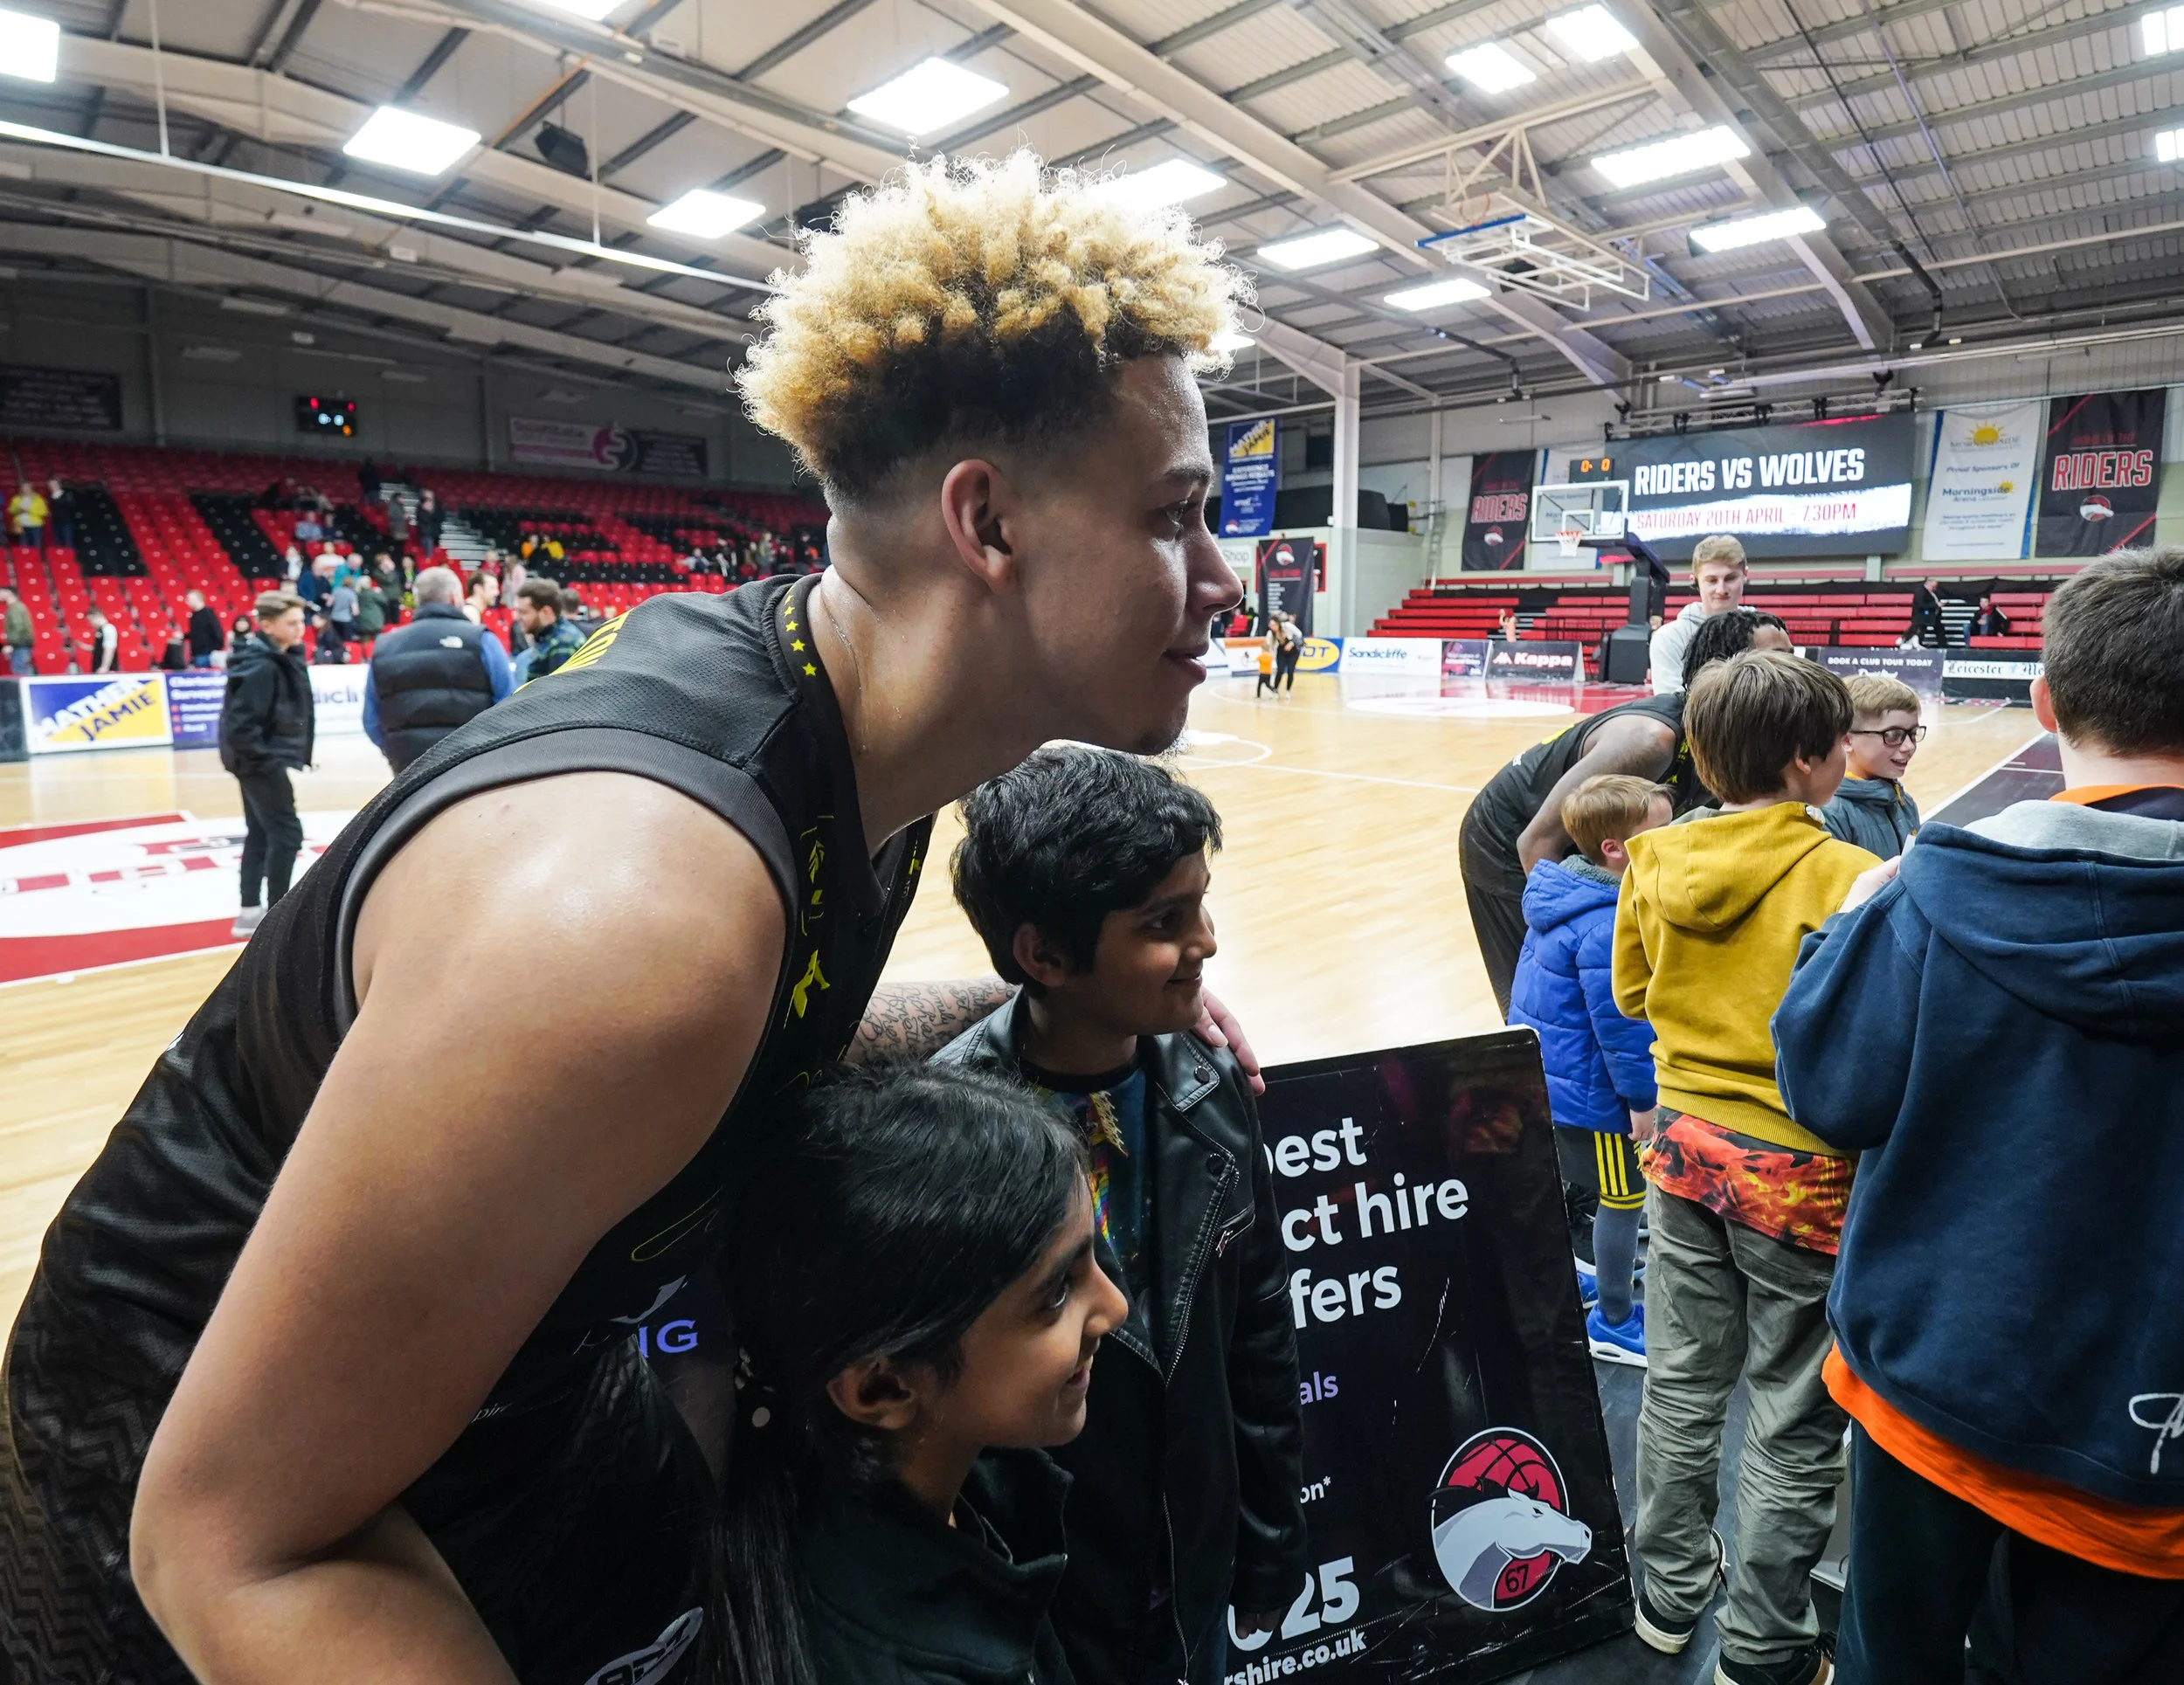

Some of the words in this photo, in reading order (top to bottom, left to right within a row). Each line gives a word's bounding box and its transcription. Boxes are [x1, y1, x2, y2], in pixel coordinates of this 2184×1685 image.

[1634, 459, 1716, 495] RIDERS
[1721, 457, 1752, 490] VS
[1759, 447, 1865, 487] WOLVES
[2052, 449, 2153, 492] RIDERS
[1942, 486, 2010, 497] Morningside
[1471, 493, 1528, 524] RIDERS
[1636, 510, 1701, 530] SATURDAY
[1706, 508, 1740, 526] 20TH
[1745, 506, 1785, 524] APRIL
[1348, 646, 1408, 659] Sandicliffe
[1514, 652, 1573, 668] Kappa
[1882, 658, 1904, 666] TOUR
[1948, 661, 2002, 674] Leicester
[79, 690, 157, 742] JAMIE
[1354, 1171, 1469, 1240] hire
[1505, 1564, 1529, 1593] 67
